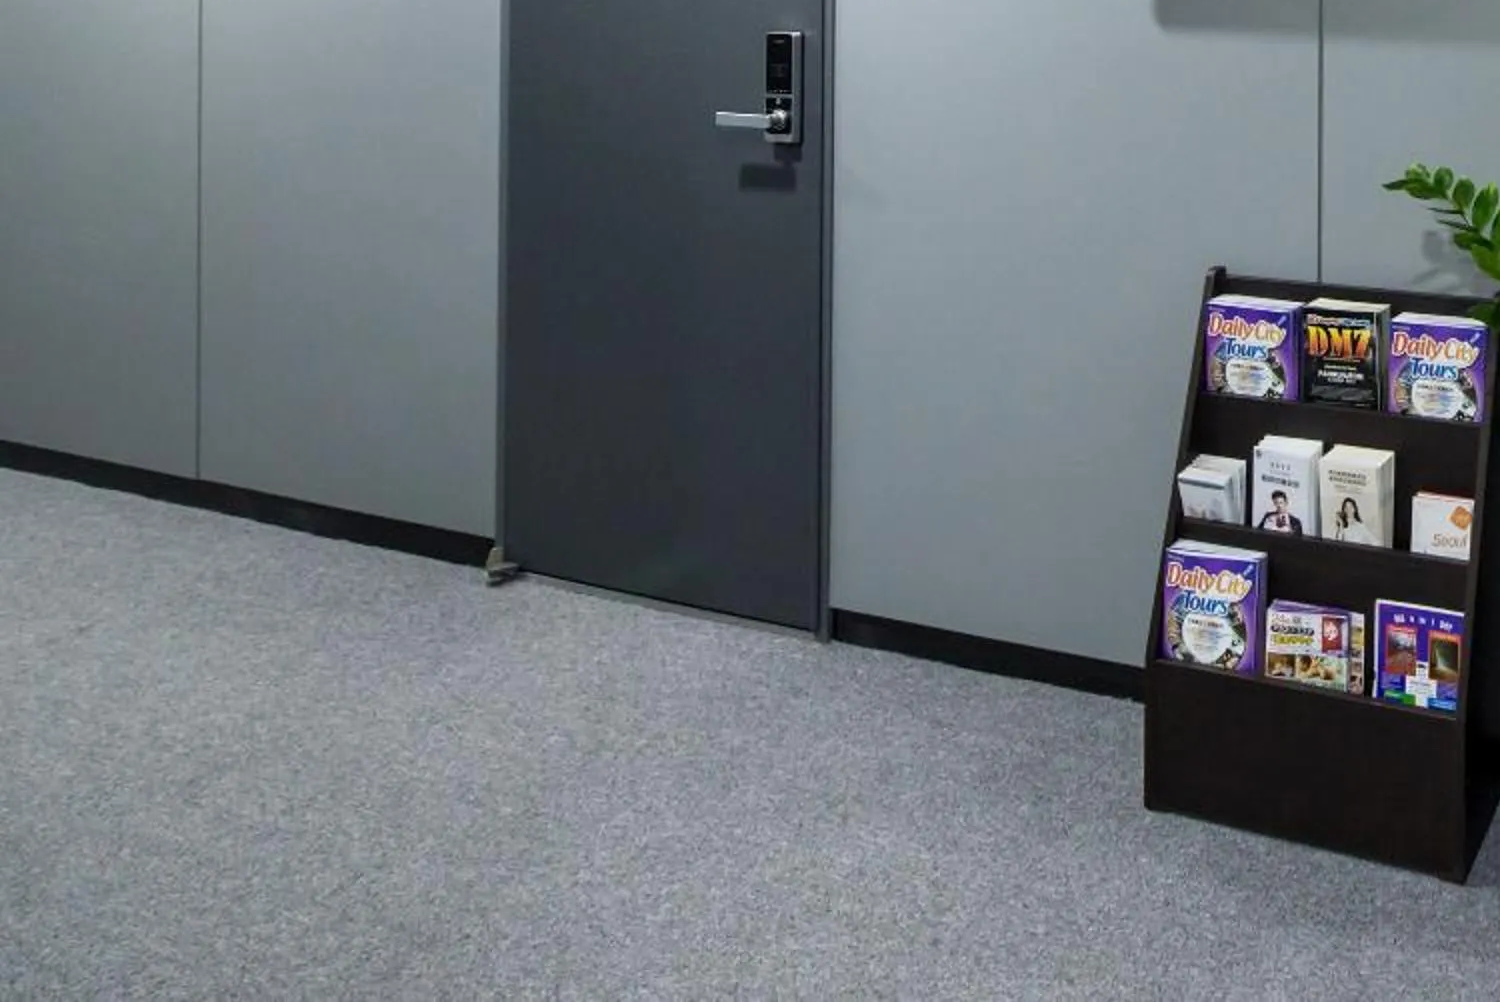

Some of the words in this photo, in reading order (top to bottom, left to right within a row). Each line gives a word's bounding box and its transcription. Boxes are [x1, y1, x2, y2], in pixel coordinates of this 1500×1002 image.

[1208, 312, 1255, 340] Daily
[1222, 338, 1267, 359] Tours
[1307, 326, 1371, 358] DMZ
[1392, 332, 1439, 360] Daily
[1442, 338, 1479, 367] City
[1411, 357, 1458, 378] Tours
[1167, 562, 1213, 592] Daily
[1214, 570, 1252, 598] City
[1182, 590, 1228, 615] Tours
